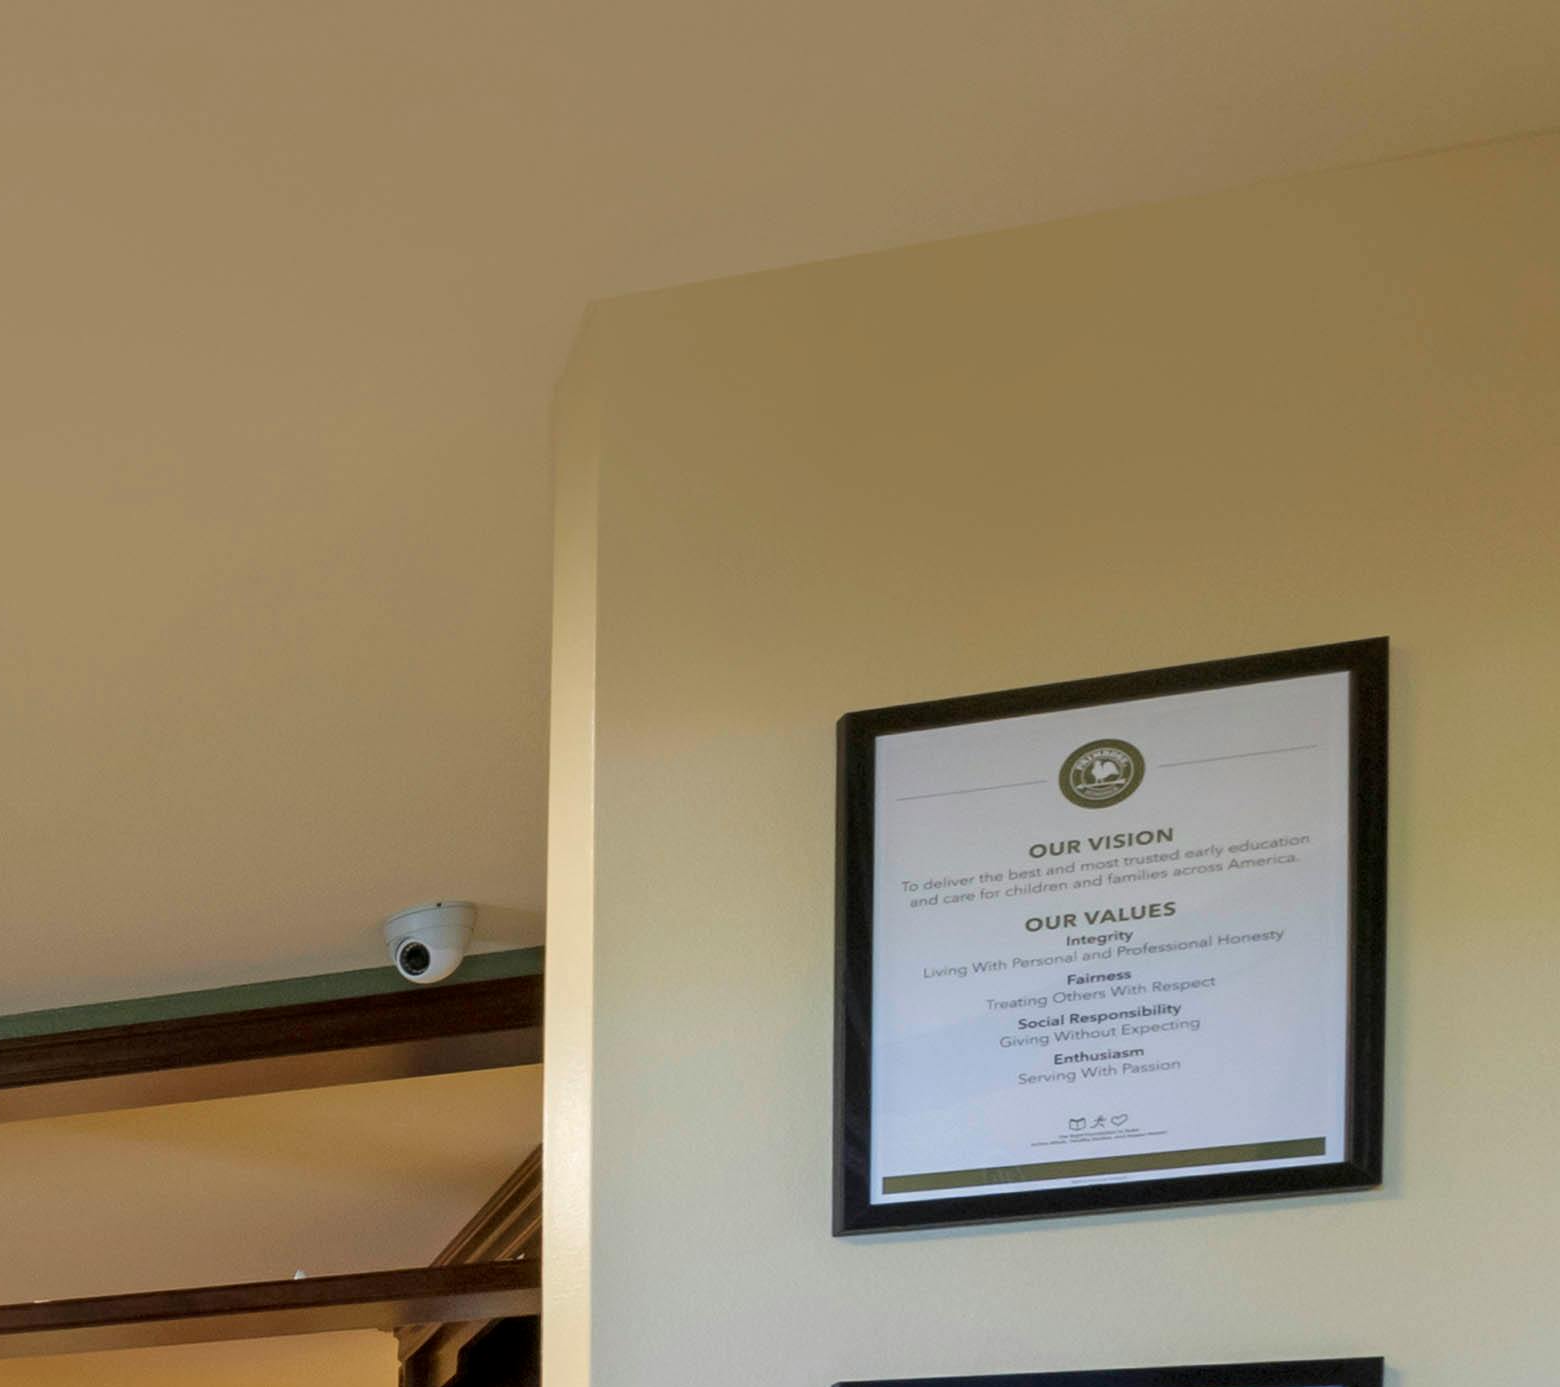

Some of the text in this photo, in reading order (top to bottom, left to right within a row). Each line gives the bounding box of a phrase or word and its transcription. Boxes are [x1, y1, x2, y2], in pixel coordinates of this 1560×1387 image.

[1028, 828, 1174, 858] OUR VISION
[901, 834, 1311, 893] To deliver the best and most trusted early education
[909, 854, 1301, 909] and care for children and families across America.
[1025, 901, 1176, 932] OUR VALUES
[1066, 930, 1134, 946] Integrity
[922, 929, 1285, 979] Living With Personal and Professional Honesty
[1067, 970, 1132, 985] Fairness
[986, 976, 1216, 1010] Treating Others With Respect
[1017, 1003, 1182, 1030] Social Responsibility
[999, 1018, 1200, 1048] Giving Without Expecting
[1053, 1048, 1145, 1066] Enthusiasm
[1018, 1060, 1181, 1085] Serving With Passion
